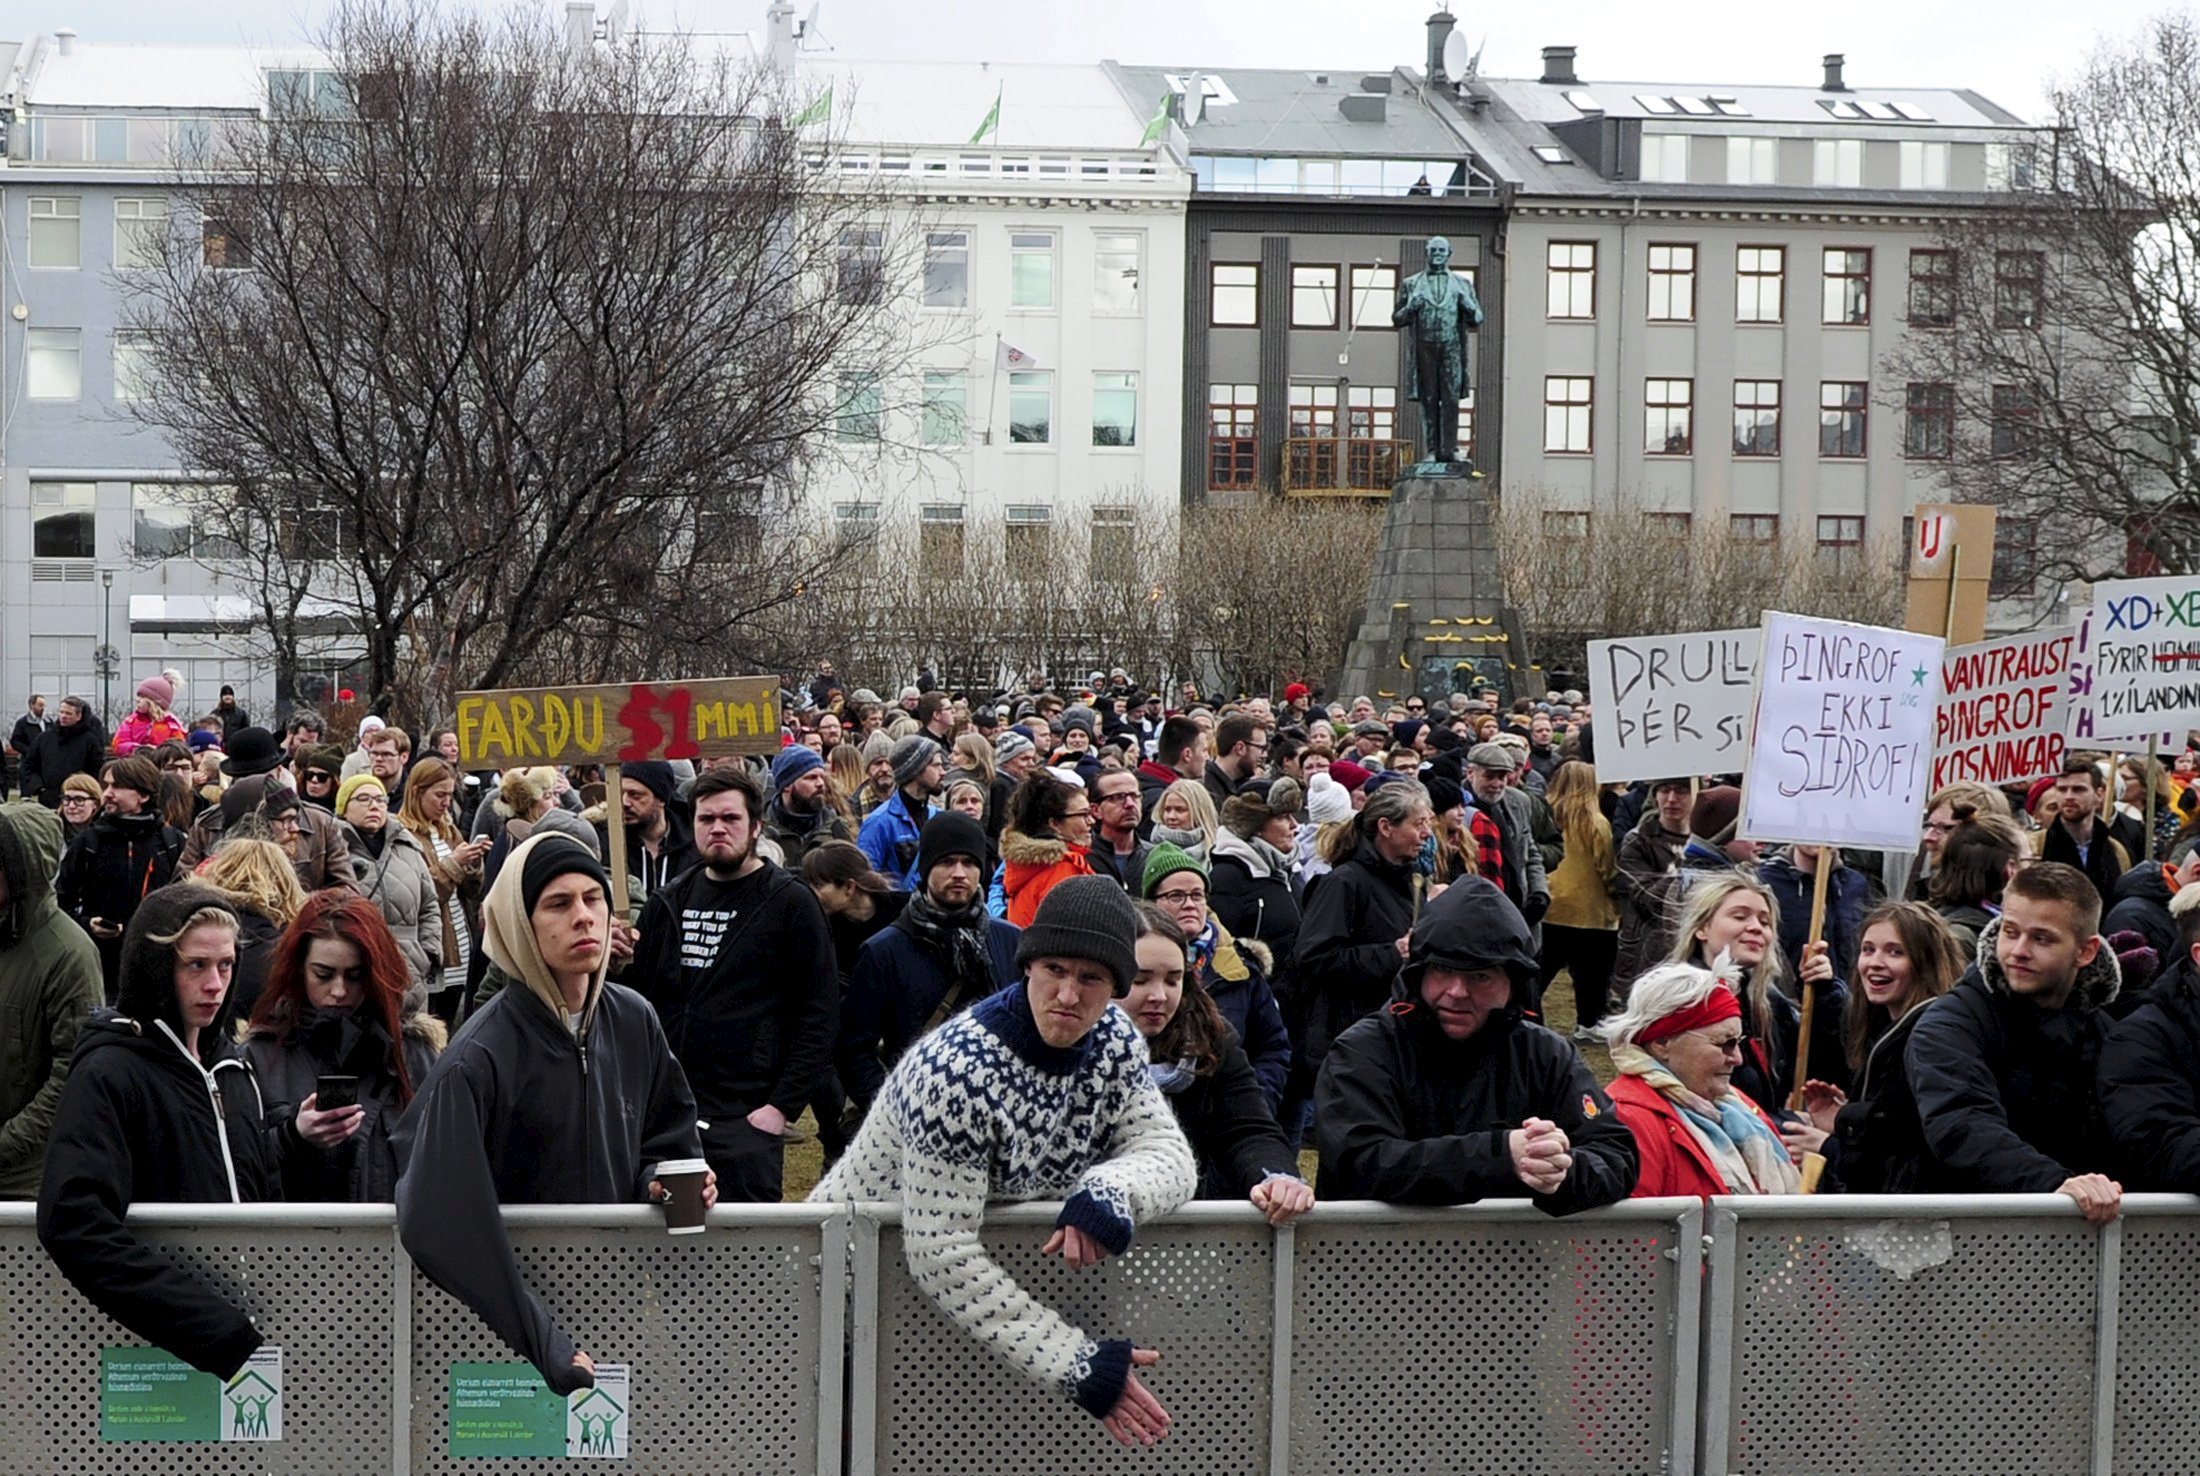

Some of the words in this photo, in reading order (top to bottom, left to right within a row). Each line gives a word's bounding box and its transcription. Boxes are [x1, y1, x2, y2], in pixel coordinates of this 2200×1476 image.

[1607, 639, 1758, 707] DRULL
[1781, 633, 1902, 684] ÞINGROF
[1941, 635, 2075, 696] VANTRAUST
[2097, 641, 2148, 677] FYRIR
[456, 693, 604, 762] FARÐU
[1616, 697, 1703, 749] ÞÉR
[1820, 692, 1893, 733] EKKI
[1935, 684, 2058, 749] ÞINGROF
[1777, 724, 1919, 804] SIÐROF!
[1932, 732, 2065, 795] KOSNINGAR
